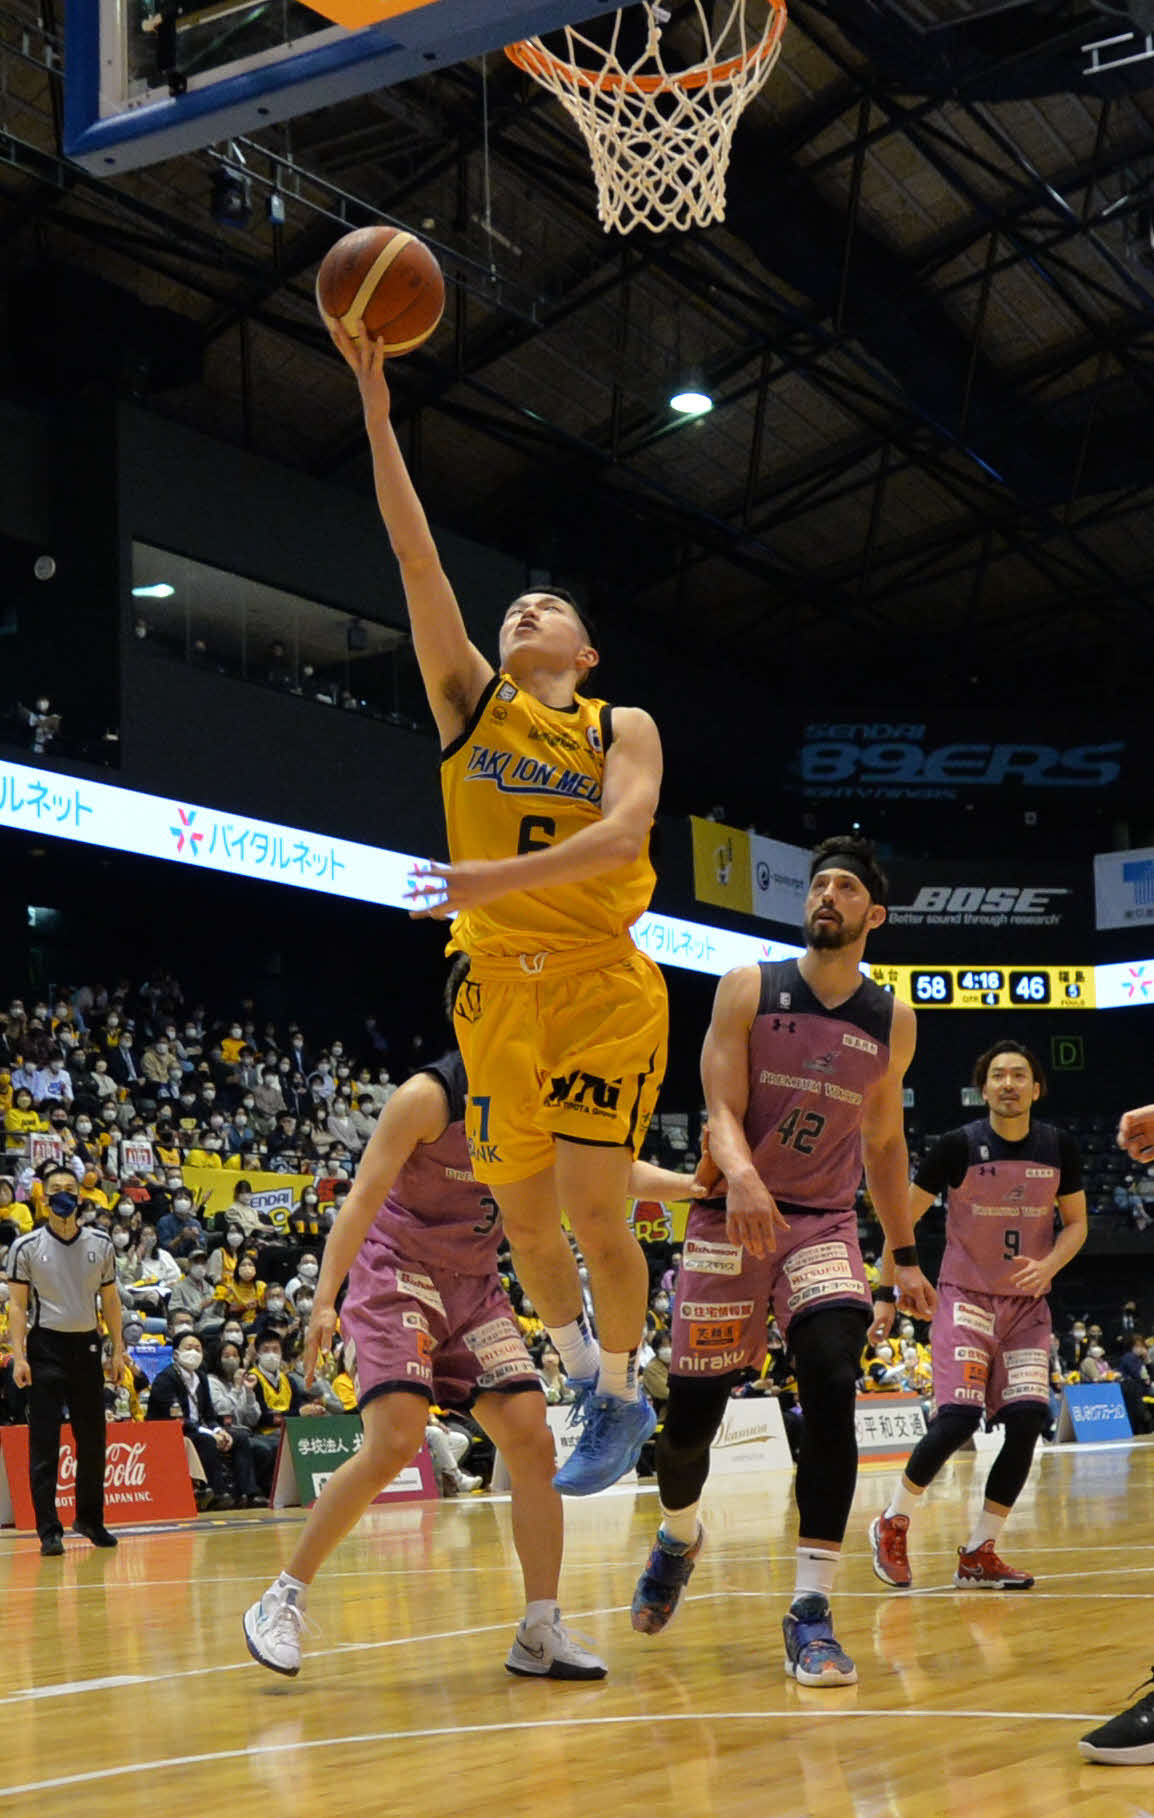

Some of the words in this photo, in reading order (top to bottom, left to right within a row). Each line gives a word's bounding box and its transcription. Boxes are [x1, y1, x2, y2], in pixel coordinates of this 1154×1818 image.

[801, 741, 1126, 787] 89ERS
[517, 814, 556, 856] 6
[209, 823, 345, 880] バイタルネット
[888, 886, 1069, 912] BOSE
[888, 912, 924, 924] Better
[926, 913, 962, 924] sound
[963, 913, 1008, 928] through
[1010, 914, 1060, 925] research
[916, 975, 947, 1000] 58
[961, 971, 1000, 989] 4:16
[1016, 975, 1045, 1000] 46
[986, 991, 995, 1005] 4
[1060, 1042, 1077, 1065] D
[777, 1107, 827, 1156] 42
[249, 1192, 289, 1209] ENDAI
[1003, 1230, 1020, 1260] 9
[679, 1350, 745, 1371] niraku
[863, 1413, 926, 1439] 平和交通
